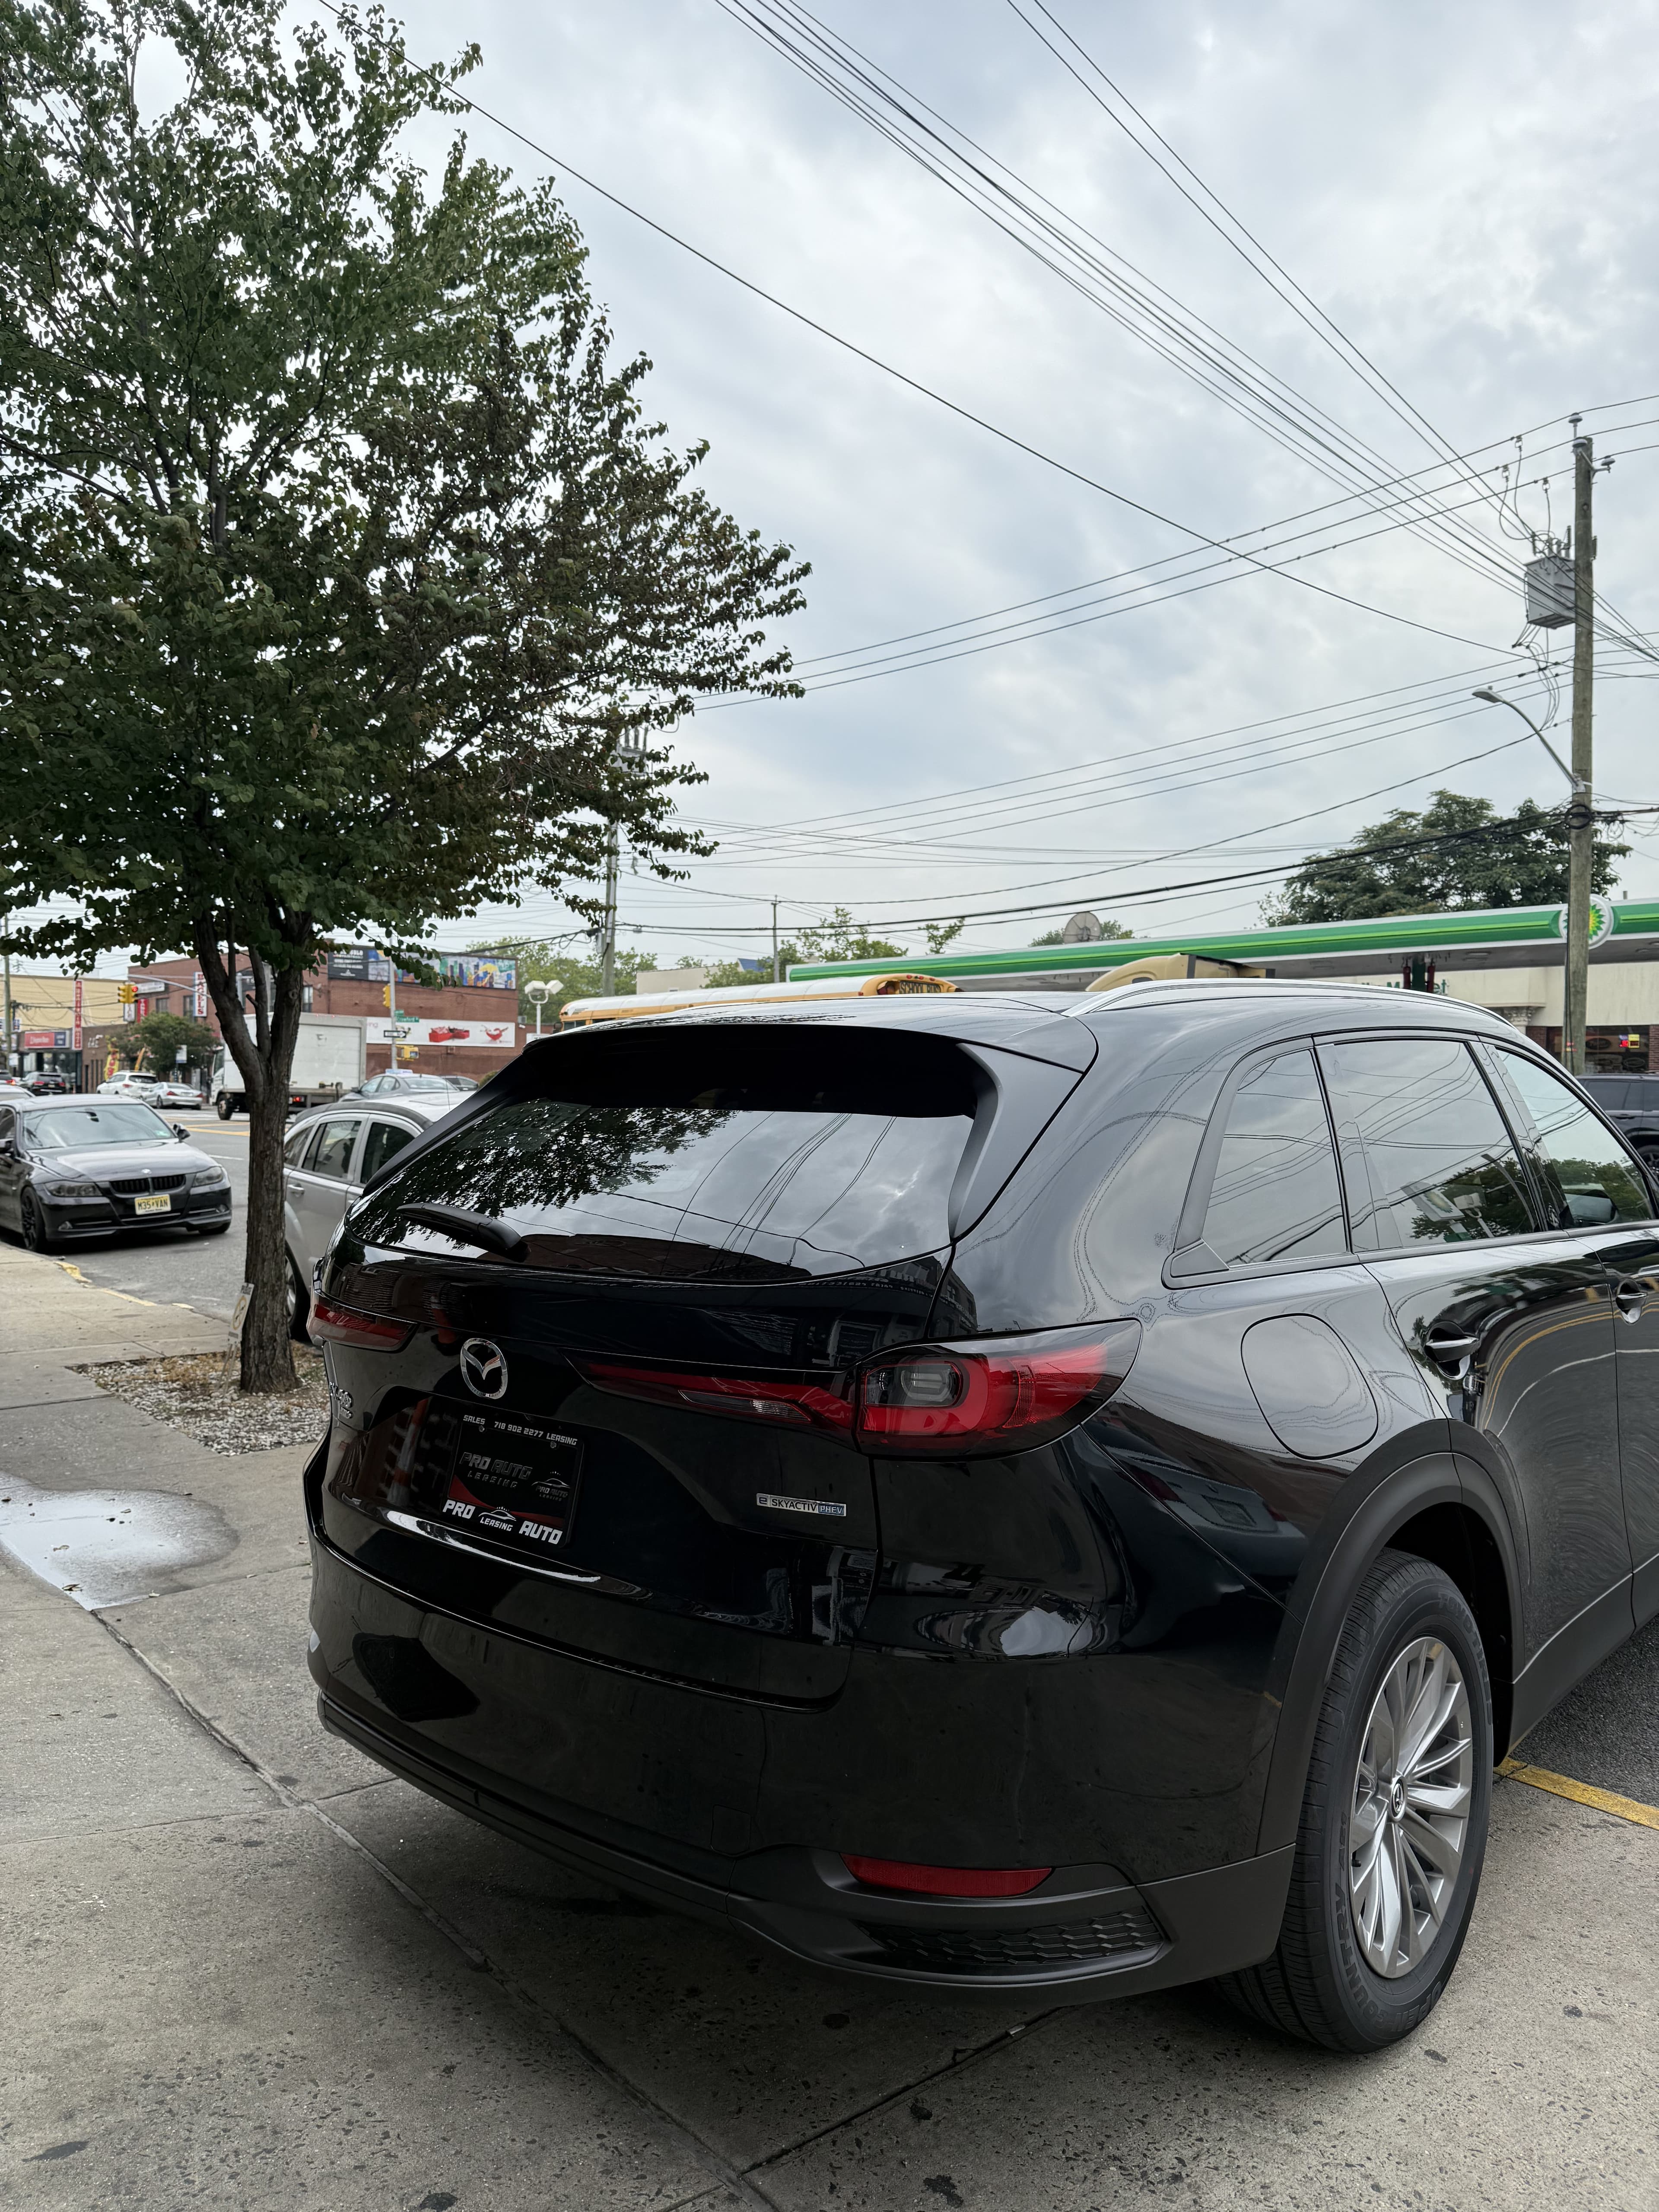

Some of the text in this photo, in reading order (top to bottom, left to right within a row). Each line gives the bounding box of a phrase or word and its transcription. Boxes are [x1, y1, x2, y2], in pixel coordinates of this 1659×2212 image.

[463, 1414, 485, 1424] SALES
[507, 1424, 522, 1433] 902
[524, 1428, 543, 1437] 2277
[546, 1433, 578, 1446] LEASING
[459, 1452, 533, 1480] PRO AUTO
[467, 1471, 519, 1489] LEASING
[771, 1498, 818, 1511] SKYACTIV
[820, 1505, 843, 1514] PHEV
[442, 1500, 563, 1545] PRO LEASING AUTO
